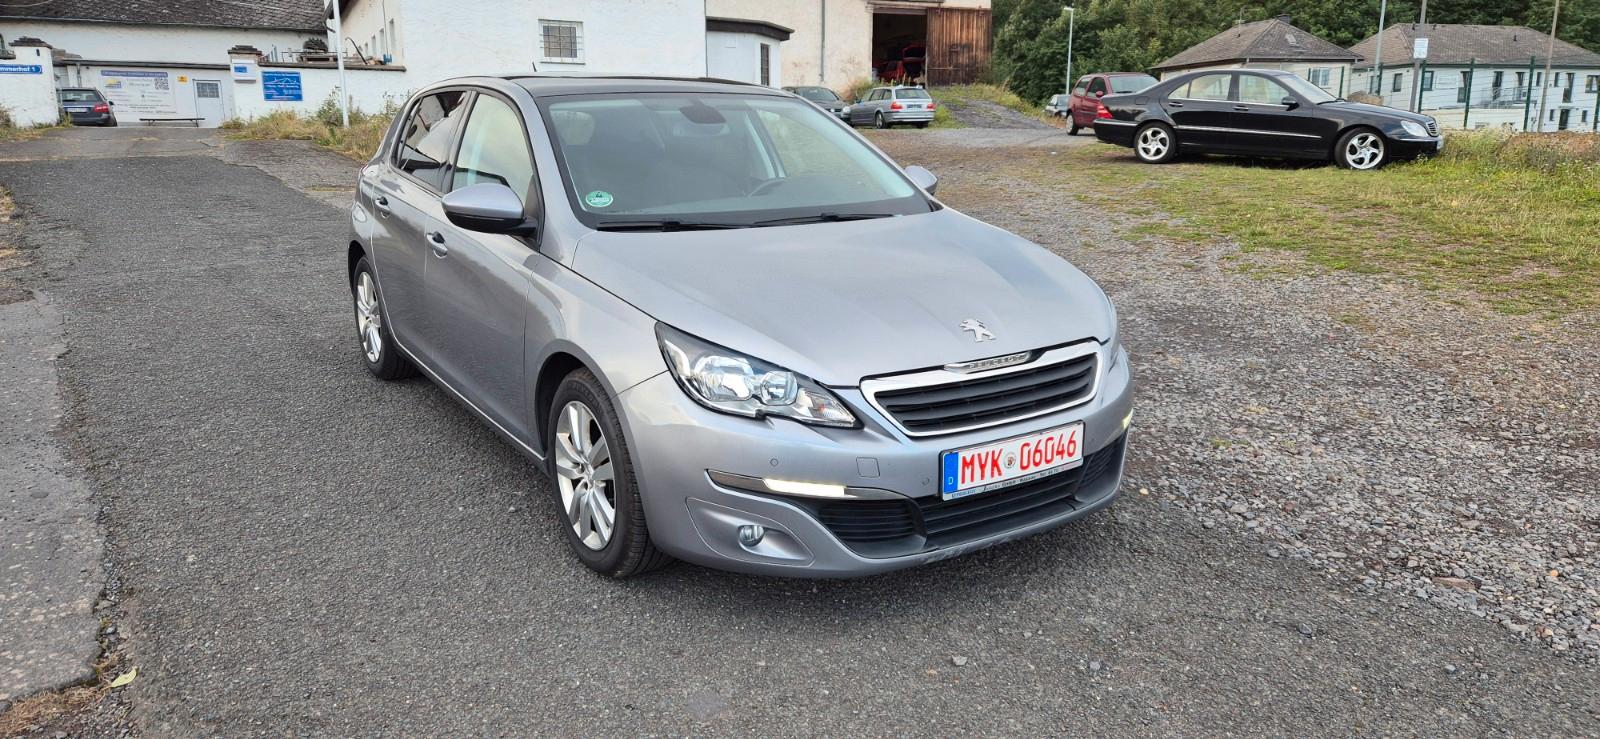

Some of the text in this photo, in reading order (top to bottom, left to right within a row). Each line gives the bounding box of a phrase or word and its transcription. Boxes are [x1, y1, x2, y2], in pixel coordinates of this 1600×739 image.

[960, 431, 1077, 484] MYK 06046
[948, 476, 954, 485] D
